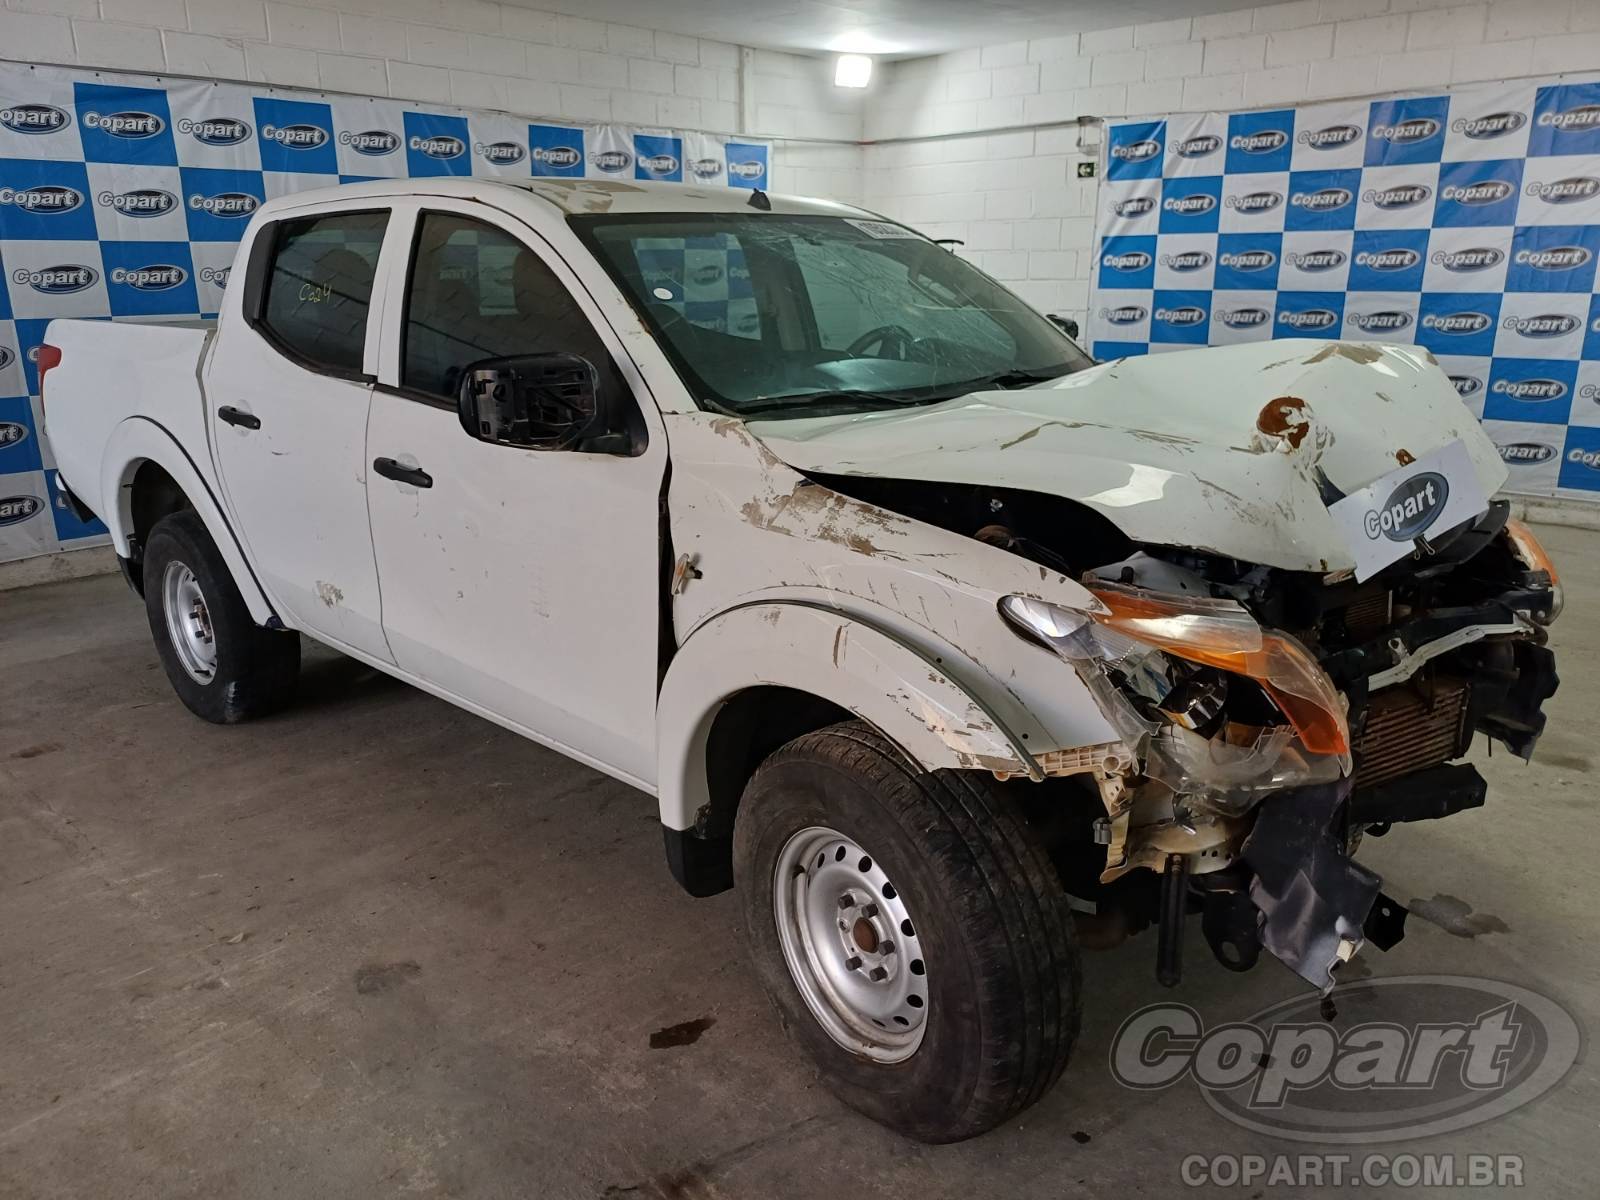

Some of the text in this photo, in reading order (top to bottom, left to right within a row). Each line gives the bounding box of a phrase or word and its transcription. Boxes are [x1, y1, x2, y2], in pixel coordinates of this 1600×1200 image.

[0, 109, 60, 127] opart
[83, 111, 156, 133] Copart
[1452, 114, 1517, 136] Copart
[177, 118, 243, 137] Copart
[262, 124, 322, 144] Copart
[1372, 121, 1433, 139] Copart
[339, 131, 394, 150] Copart
[409, 136, 459, 154] Copart
[1230, 134, 1280, 148] Copart
[1297, 128, 1354, 146] Copart
[475, 143, 520, 159] Copart
[532, 148, 577, 163] Copart
[1168, 138, 1217, 155] Copart
[0, 187, 74, 208] Copart
[1362, 187, 1424, 206] Copart
[1441, 184, 1507, 203] Copart
[1526, 180, 1595, 199] Copart
[98, 191, 169, 211] Copart
[190, 194, 251, 212] Copart
[1163, 196, 1211, 211] Copart
[1224, 194, 1274, 210] Copart
[1291, 190, 1346, 208] Copart
[1103, 253, 1146, 268] Copart
[1159, 254, 1204, 269] Copart
[1219, 253, 1270, 268] Copart
[1285, 252, 1338, 267] Copart
[1355, 251, 1414, 267] Copart
[1431, 250, 1496, 267] Copart
[1515, 249, 1583, 267] Copart
[13, 268, 90, 288] Copart
[110, 267, 179, 286] Copart
[1098, 307, 1142, 321] Copart
[1155, 307, 1201, 322] Copart
[1214, 308, 1263, 324] Copart
[1278, 310, 1331, 325] Copart
[1347, 311, 1404, 327] Copart
[1422, 314, 1484, 332] Copart
[1503, 315, 1571, 333] Copart
[1492, 378, 1559, 397] Copart
[1364, 480, 1436, 540] Copart
